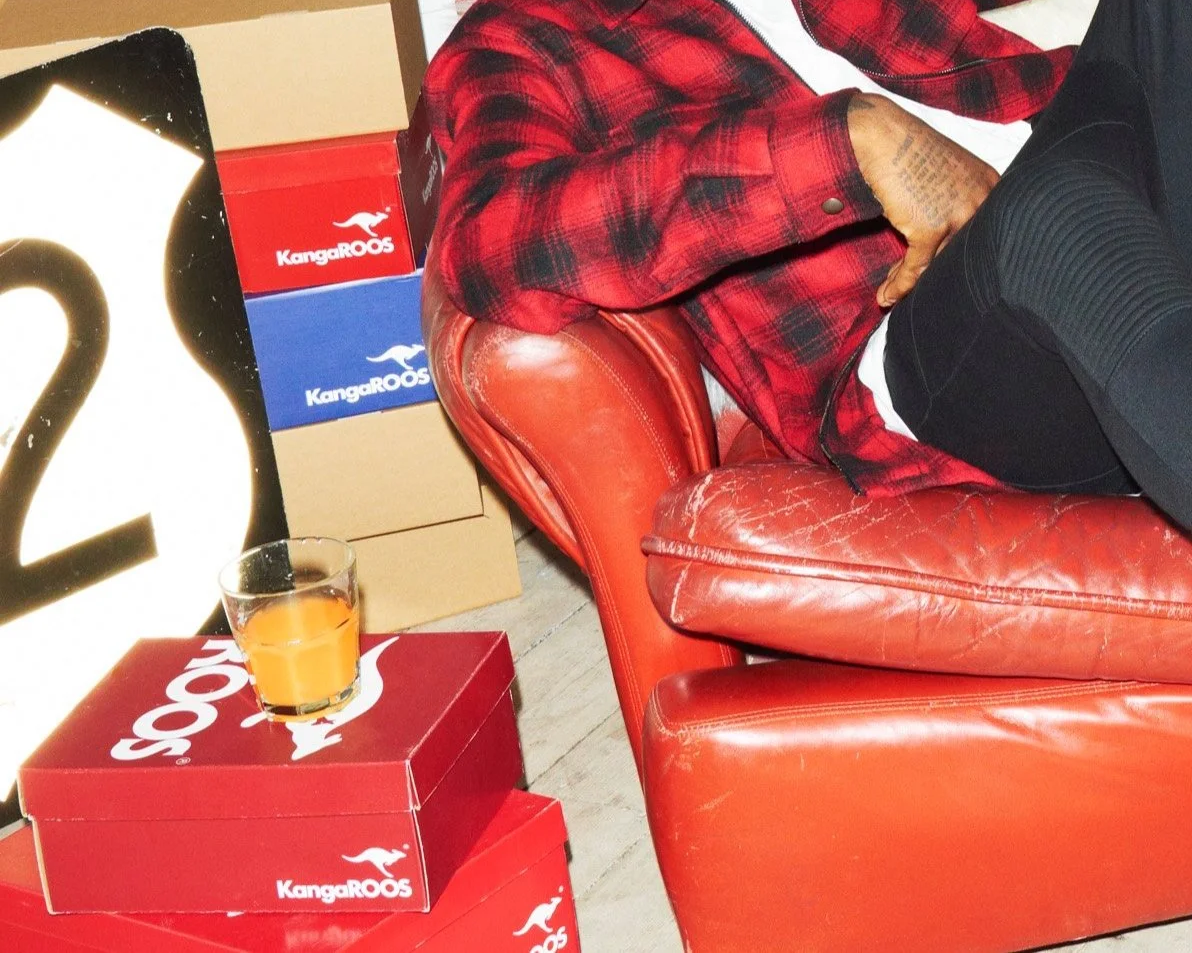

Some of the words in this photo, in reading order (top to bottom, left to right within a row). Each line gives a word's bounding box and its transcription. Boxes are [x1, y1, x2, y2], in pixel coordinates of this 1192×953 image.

[276, 237, 395, 266] KangaROOS
[305, 367, 431, 406] KangaROOS
[276, 878, 412, 904] KangaROOS
